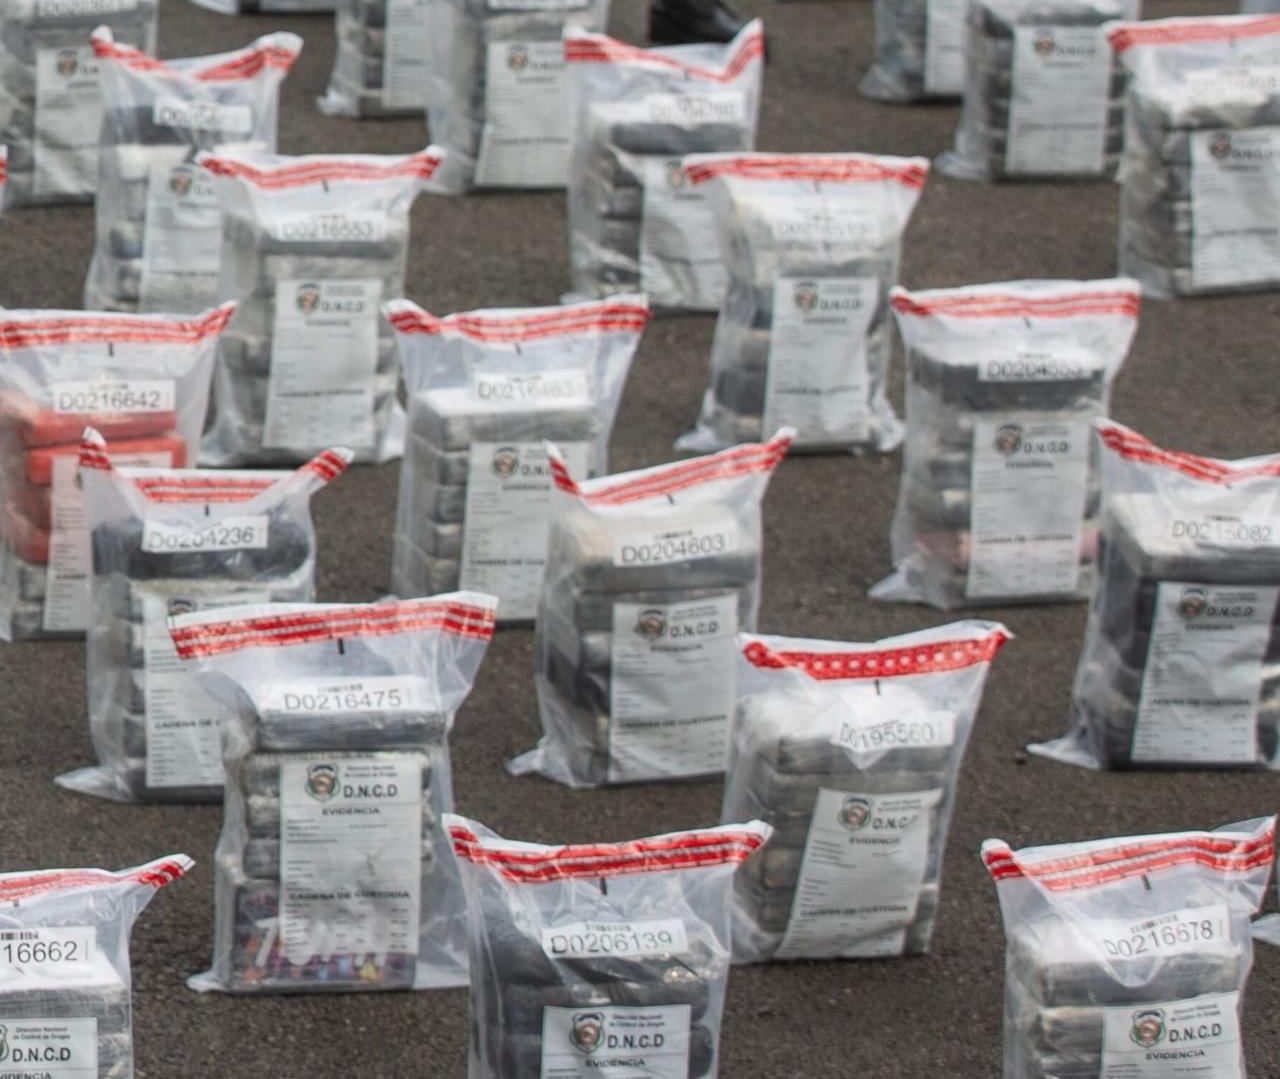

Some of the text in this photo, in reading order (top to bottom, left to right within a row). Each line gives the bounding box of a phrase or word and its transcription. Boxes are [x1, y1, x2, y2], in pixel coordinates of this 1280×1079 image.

[59, 390, 161, 411] D0216642
[148, 525, 256, 550] D0204236
[621, 535, 725, 563] D0204603
[1207, 606, 1255, 618] D.N.C.D
[669, 622, 719, 639] D.N.C.D
[284, 688, 403, 711] D0216475
[342, 784, 398, 799] D.N.C.D
[322, 807, 381, 816] EVIDENCIA
[550, 930, 673, 955] D0206139
[1102, 920, 1213, 957] D0216678
[608, 1033, 665, 1049] D.N.C.D
[1168, 1023, 1222, 1042] D.N.C.D
[12, 1047, 72, 1062] D.N.C.D
[1145, 1049, 1206, 1061] EVIDENCIA
[585, 1058, 646, 1069] EVIDENCIA
